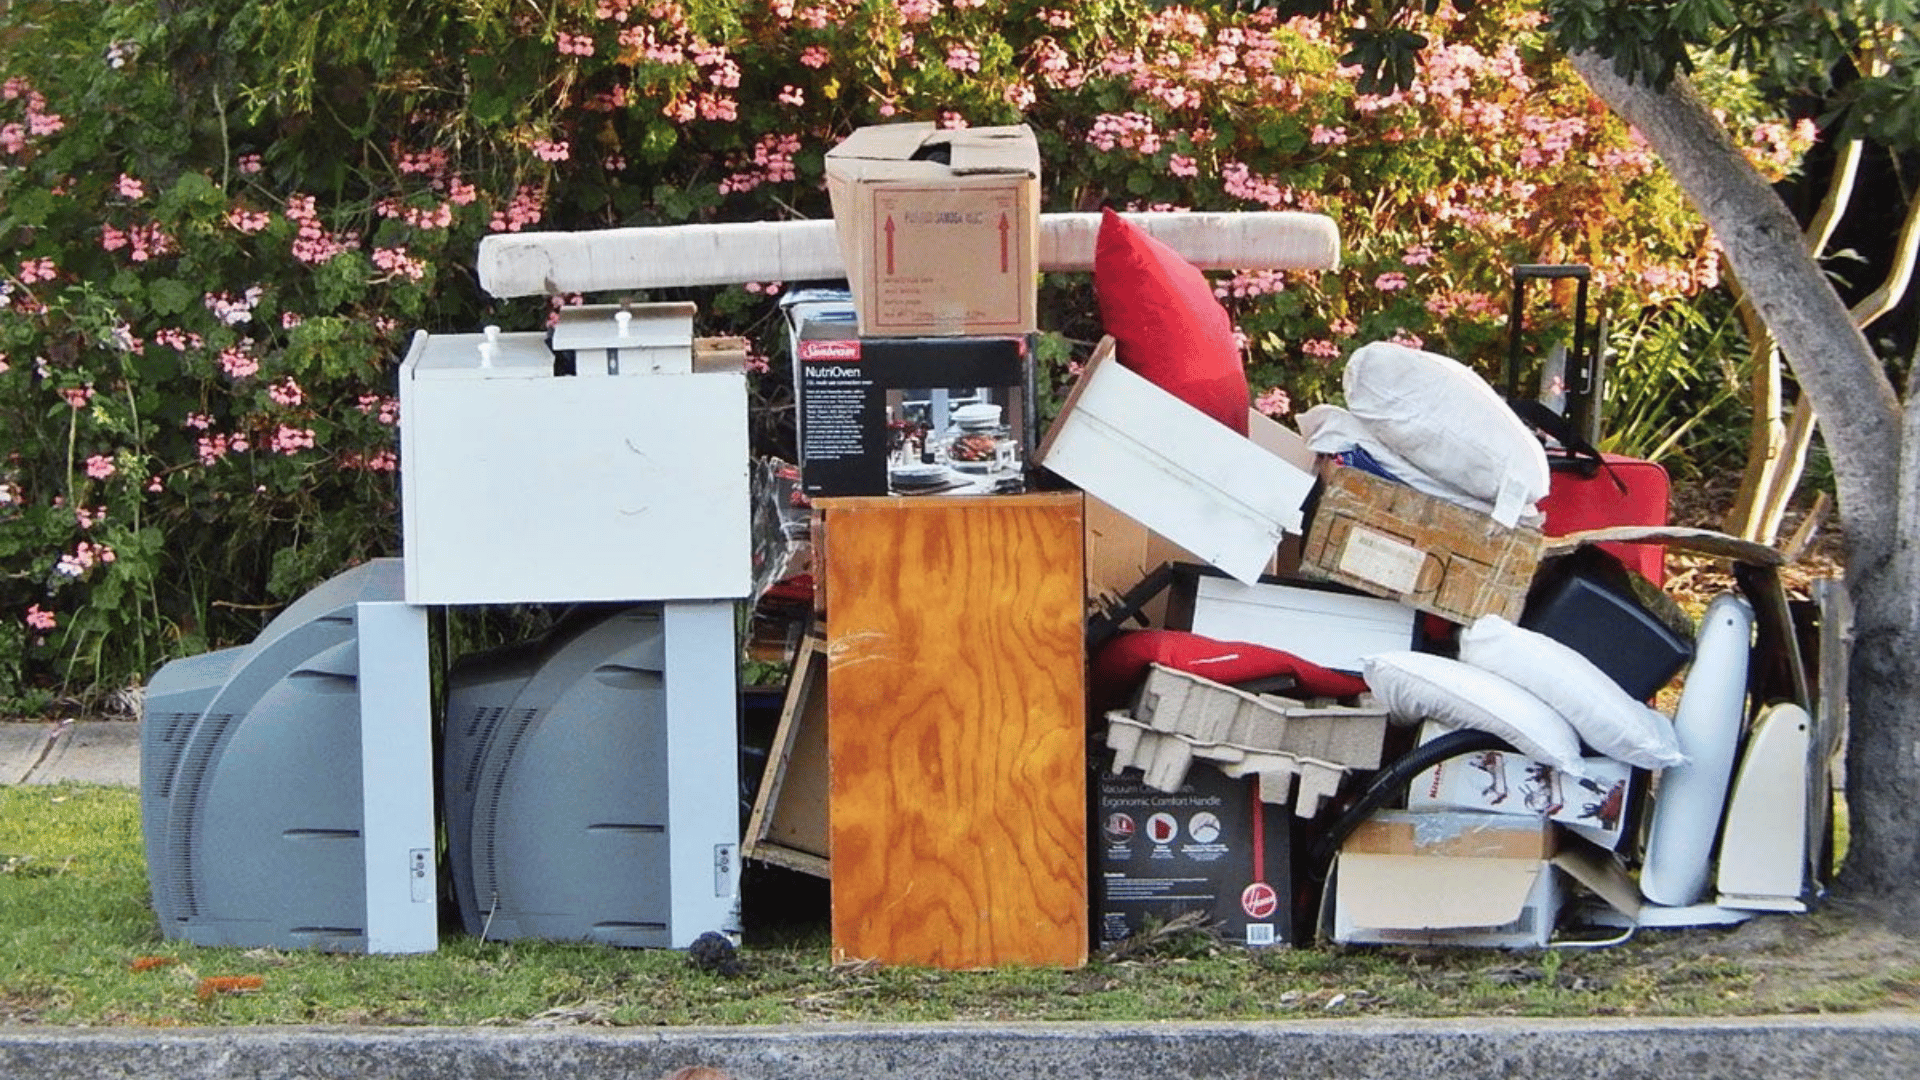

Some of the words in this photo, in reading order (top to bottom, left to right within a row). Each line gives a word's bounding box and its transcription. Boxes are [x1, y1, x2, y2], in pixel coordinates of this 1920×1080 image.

[803, 342, 855, 358] Sunbeam
[805, 366, 861, 377] NutriOven
[1102, 796, 1148, 808] Ergonomic
[1151, 796, 1188, 806] Comfort
[1189, 795, 1221, 806] Handle
